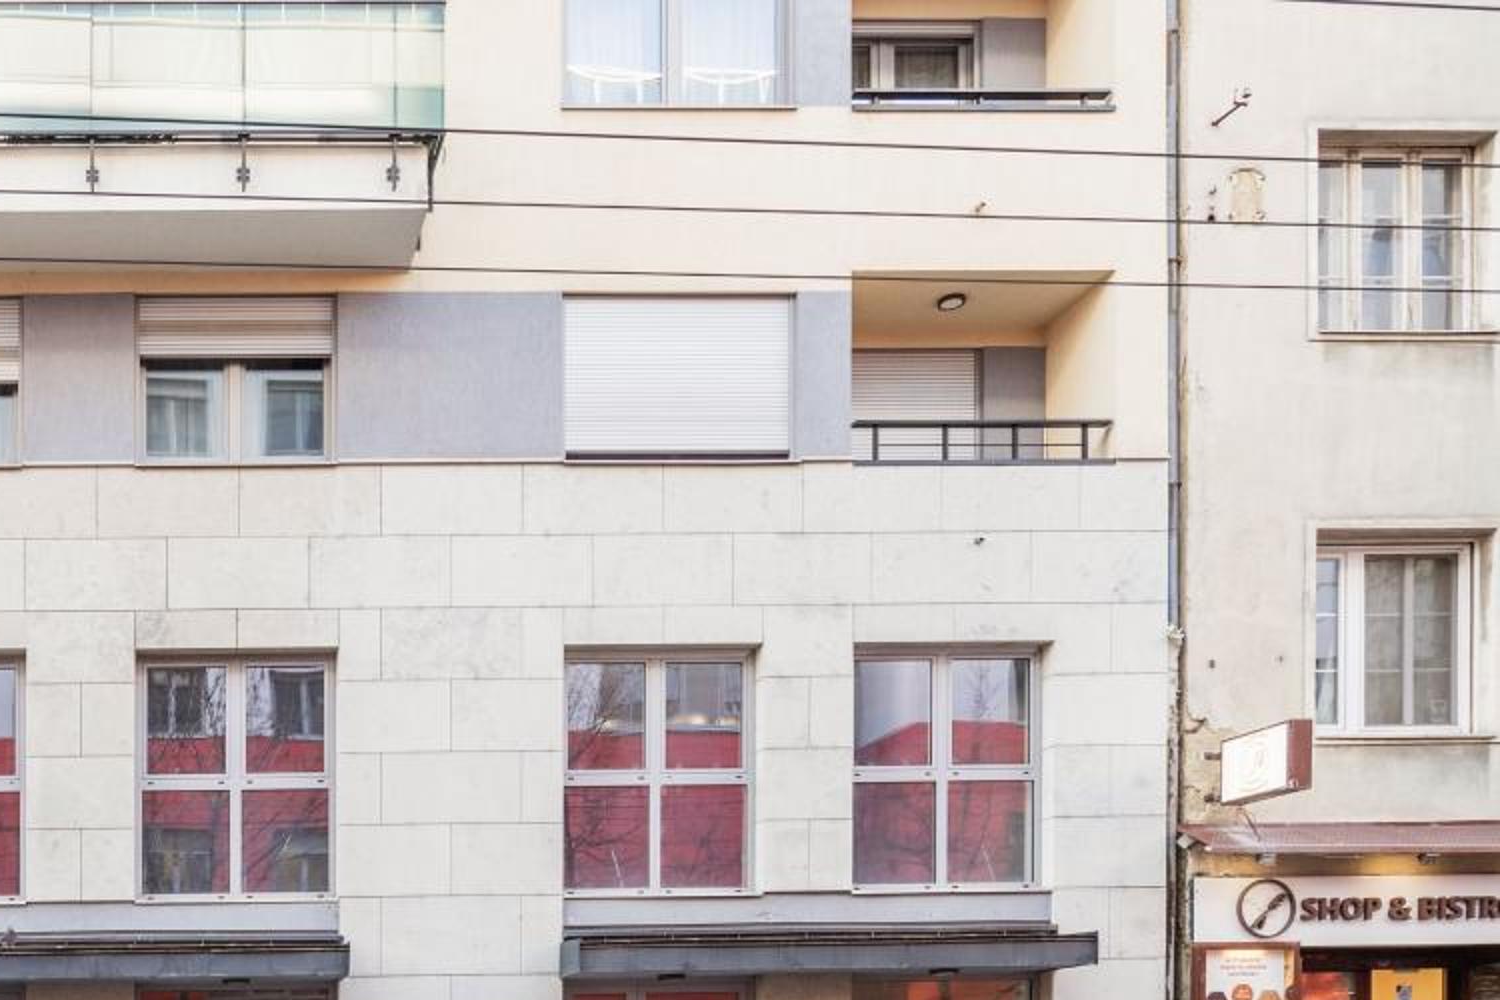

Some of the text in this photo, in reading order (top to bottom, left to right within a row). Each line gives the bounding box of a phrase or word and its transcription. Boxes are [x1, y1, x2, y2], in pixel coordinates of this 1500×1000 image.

[1300, 895, 1500, 921] SHOP & BISTR
